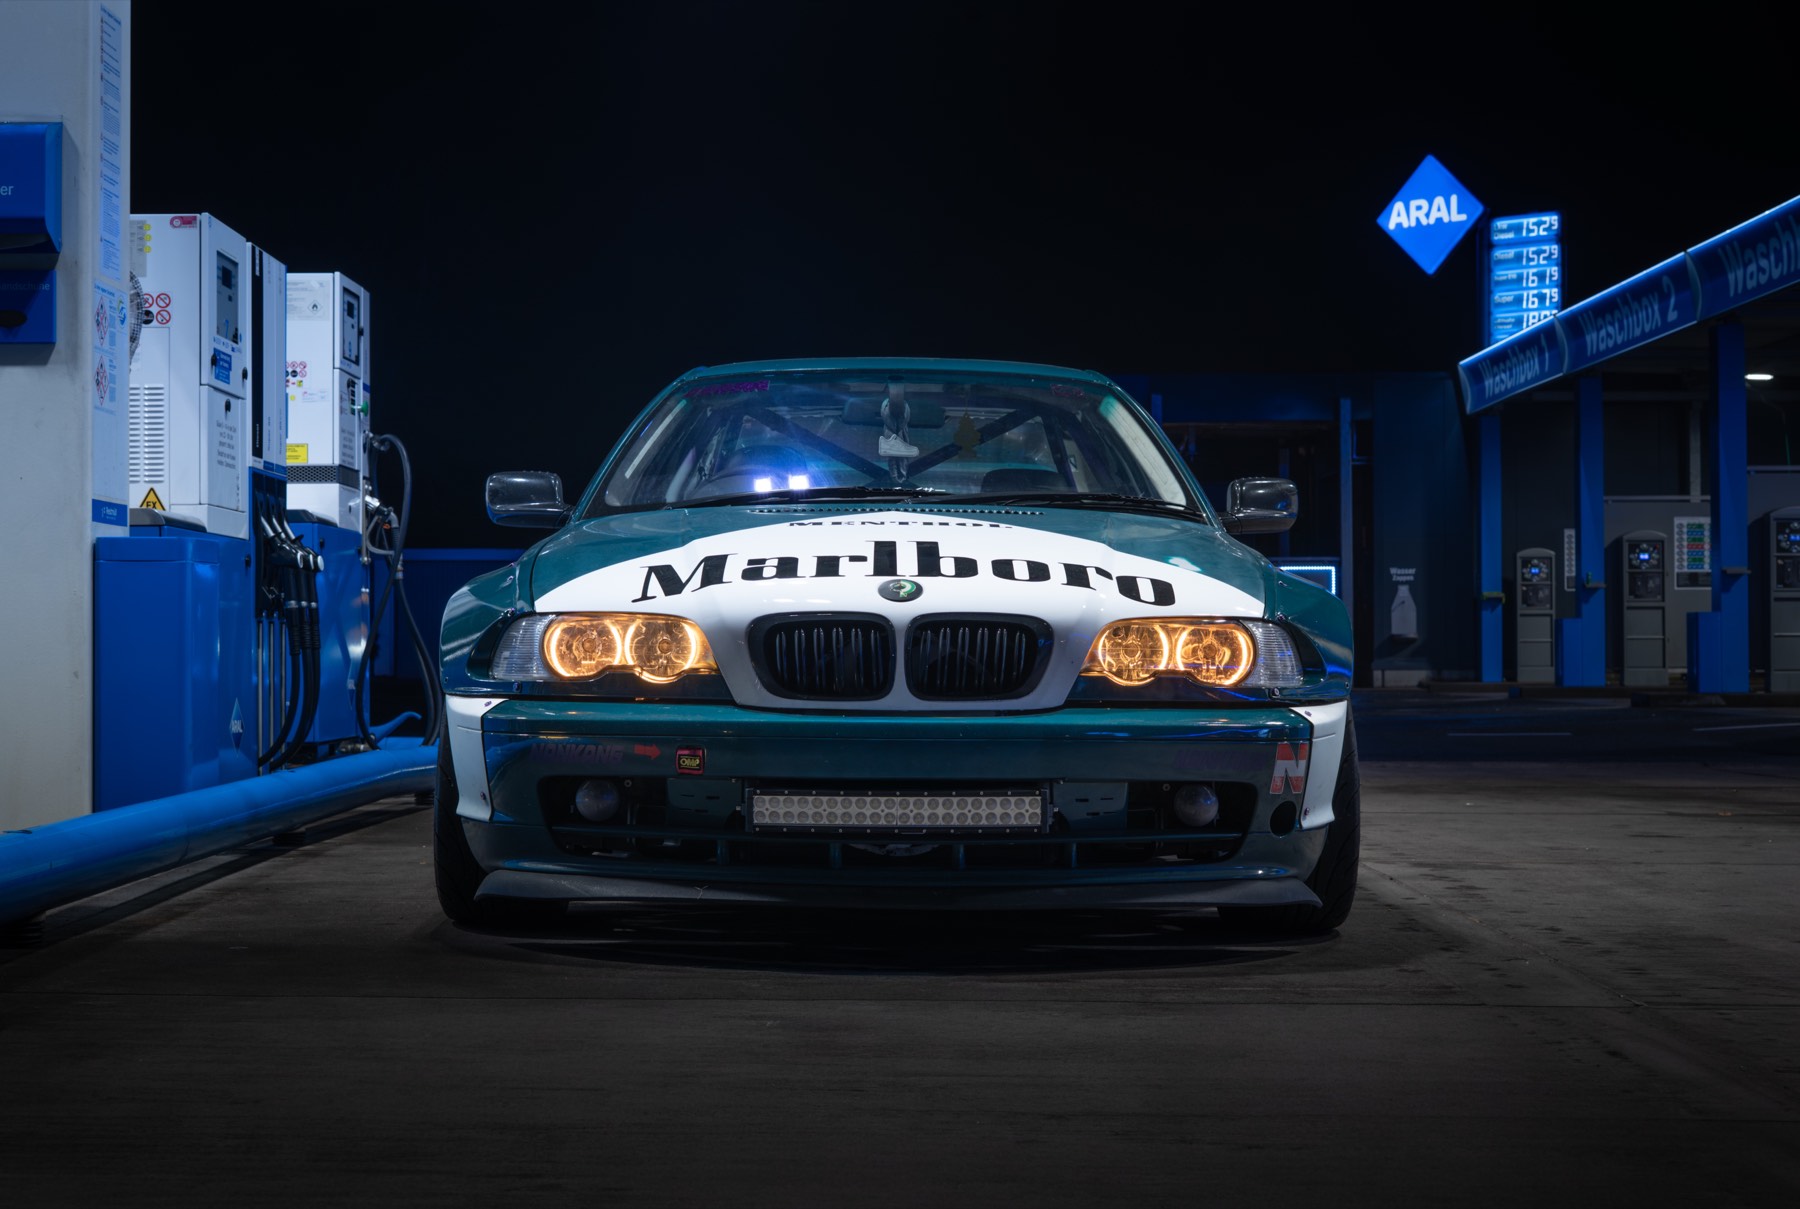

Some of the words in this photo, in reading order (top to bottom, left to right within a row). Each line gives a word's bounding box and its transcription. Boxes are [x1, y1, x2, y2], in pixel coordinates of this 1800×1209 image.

[1388, 194, 1468, 230] ARAL
[1578, 289, 1662, 357] Waschbox
[1662, 275, 1679, 322] 2
[1478, 344, 1540, 399] Waschbox
[1540, 333, 1549, 373] 1
[631, 540, 1176, 607] Marlboro
[1390, 567, 1416, 575] Wasser
[679, 757, 701, 767] OMP
